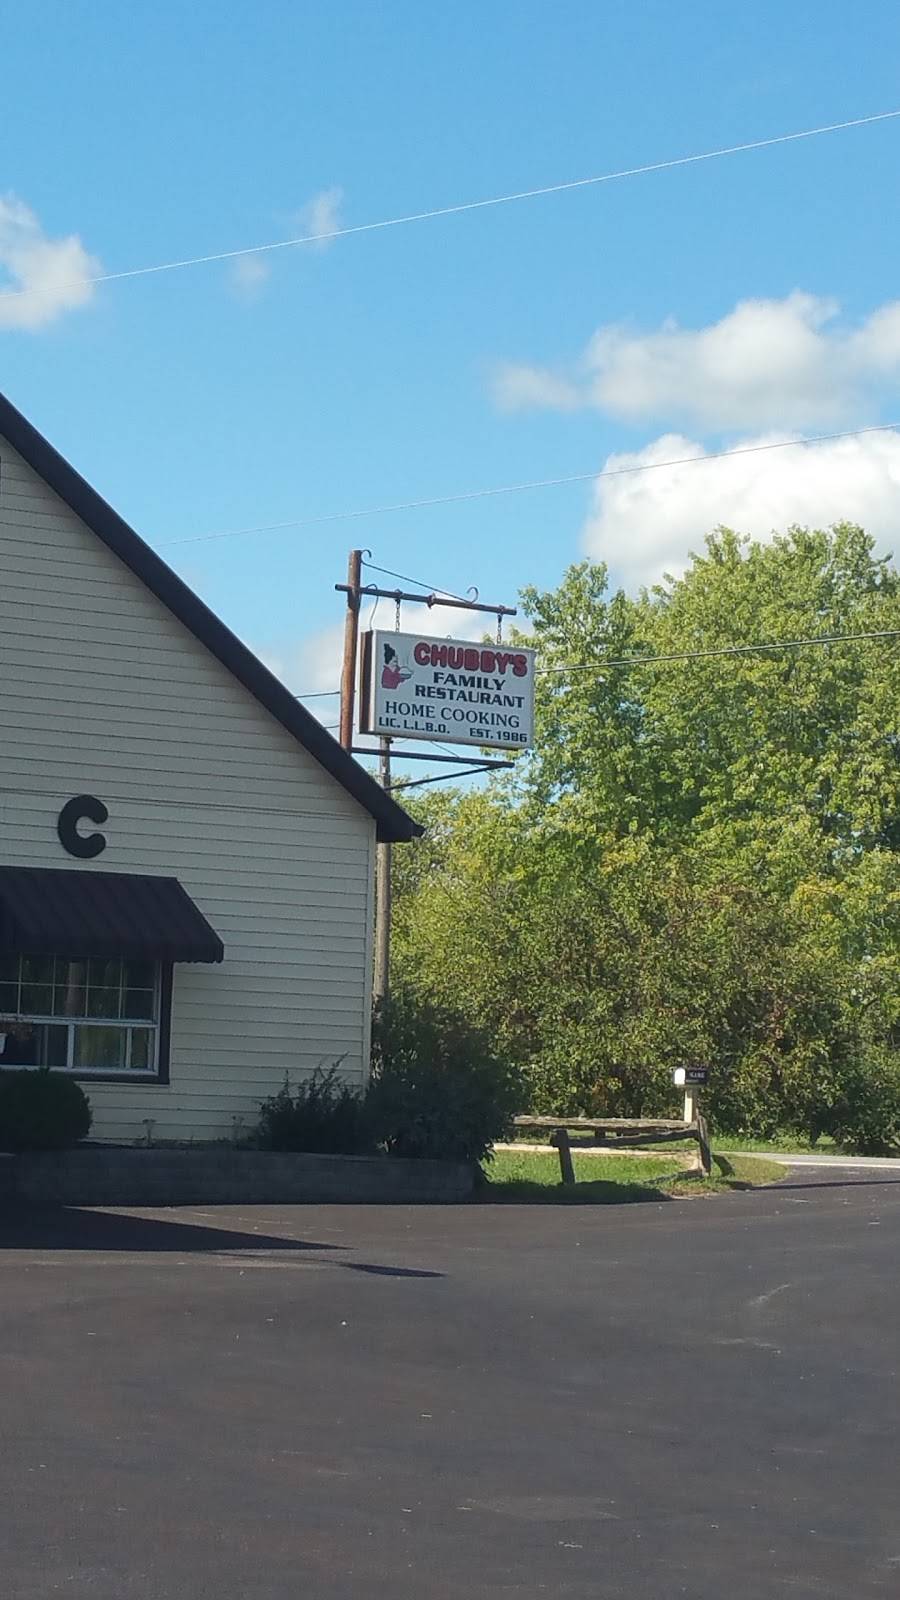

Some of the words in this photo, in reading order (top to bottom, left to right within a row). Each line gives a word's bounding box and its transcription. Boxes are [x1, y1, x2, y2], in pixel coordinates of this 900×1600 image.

[414, 642, 528, 677] CHUBBY'S
[433, 671, 506, 691] FAMILY
[415, 685, 525, 708] RESTAURANT
[378, 717, 400, 728] LIC.
[404, 720, 450, 734] L.L.B.O.
[385, 701, 436, 718] HOME
[441, 707, 520, 728] COOKING
[57, 794, 109, 859] C
